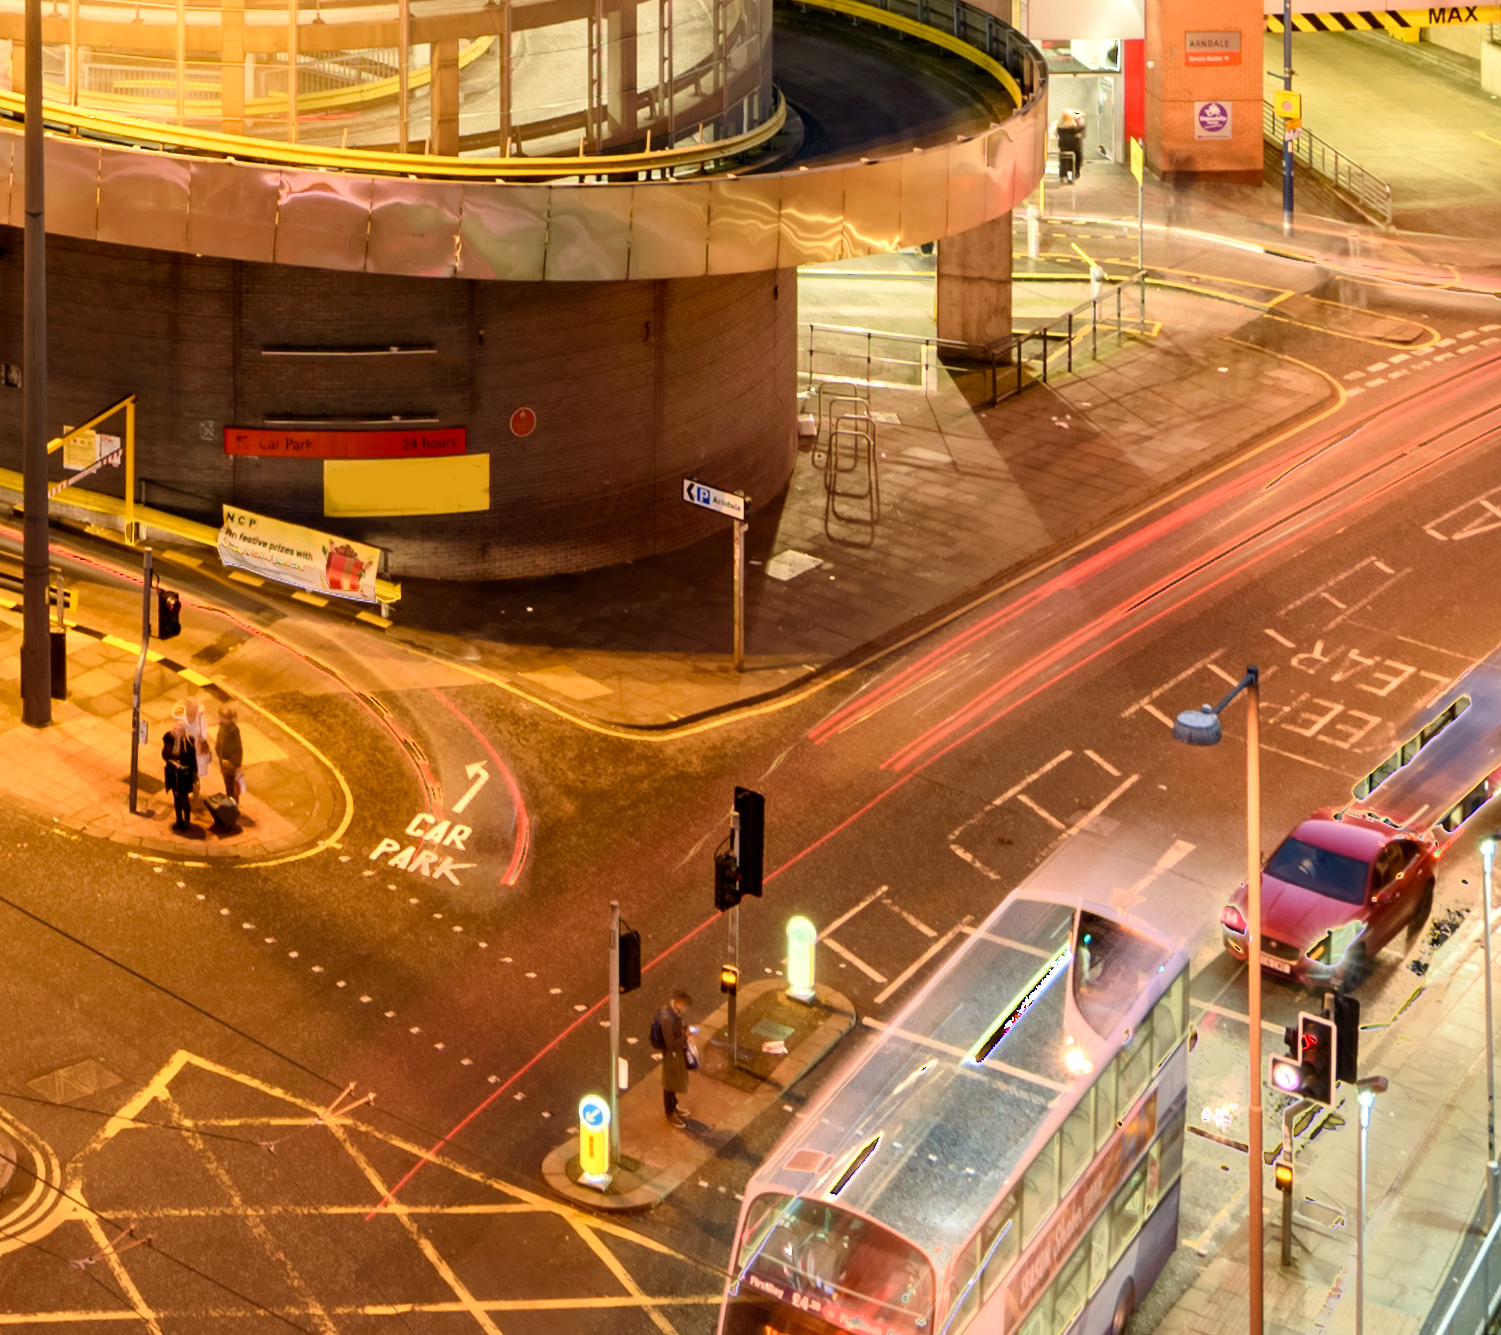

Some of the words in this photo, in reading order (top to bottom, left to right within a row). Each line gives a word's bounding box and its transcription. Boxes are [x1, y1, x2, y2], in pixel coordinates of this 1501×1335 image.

[1428, 5, 1479, 25] MAX
[1189, 39, 1230, 48] ARNDALE
[285, 437, 312, 451] Park
[402, 437, 418, 450] 24
[421, 436, 457, 450] hours
[238, 531, 268, 548] festive
[268, 541, 295, 558] prizes
[296, 547, 314, 562] with
[405, 813, 473, 851] CAR
[368, 837, 478, 886] PARK
